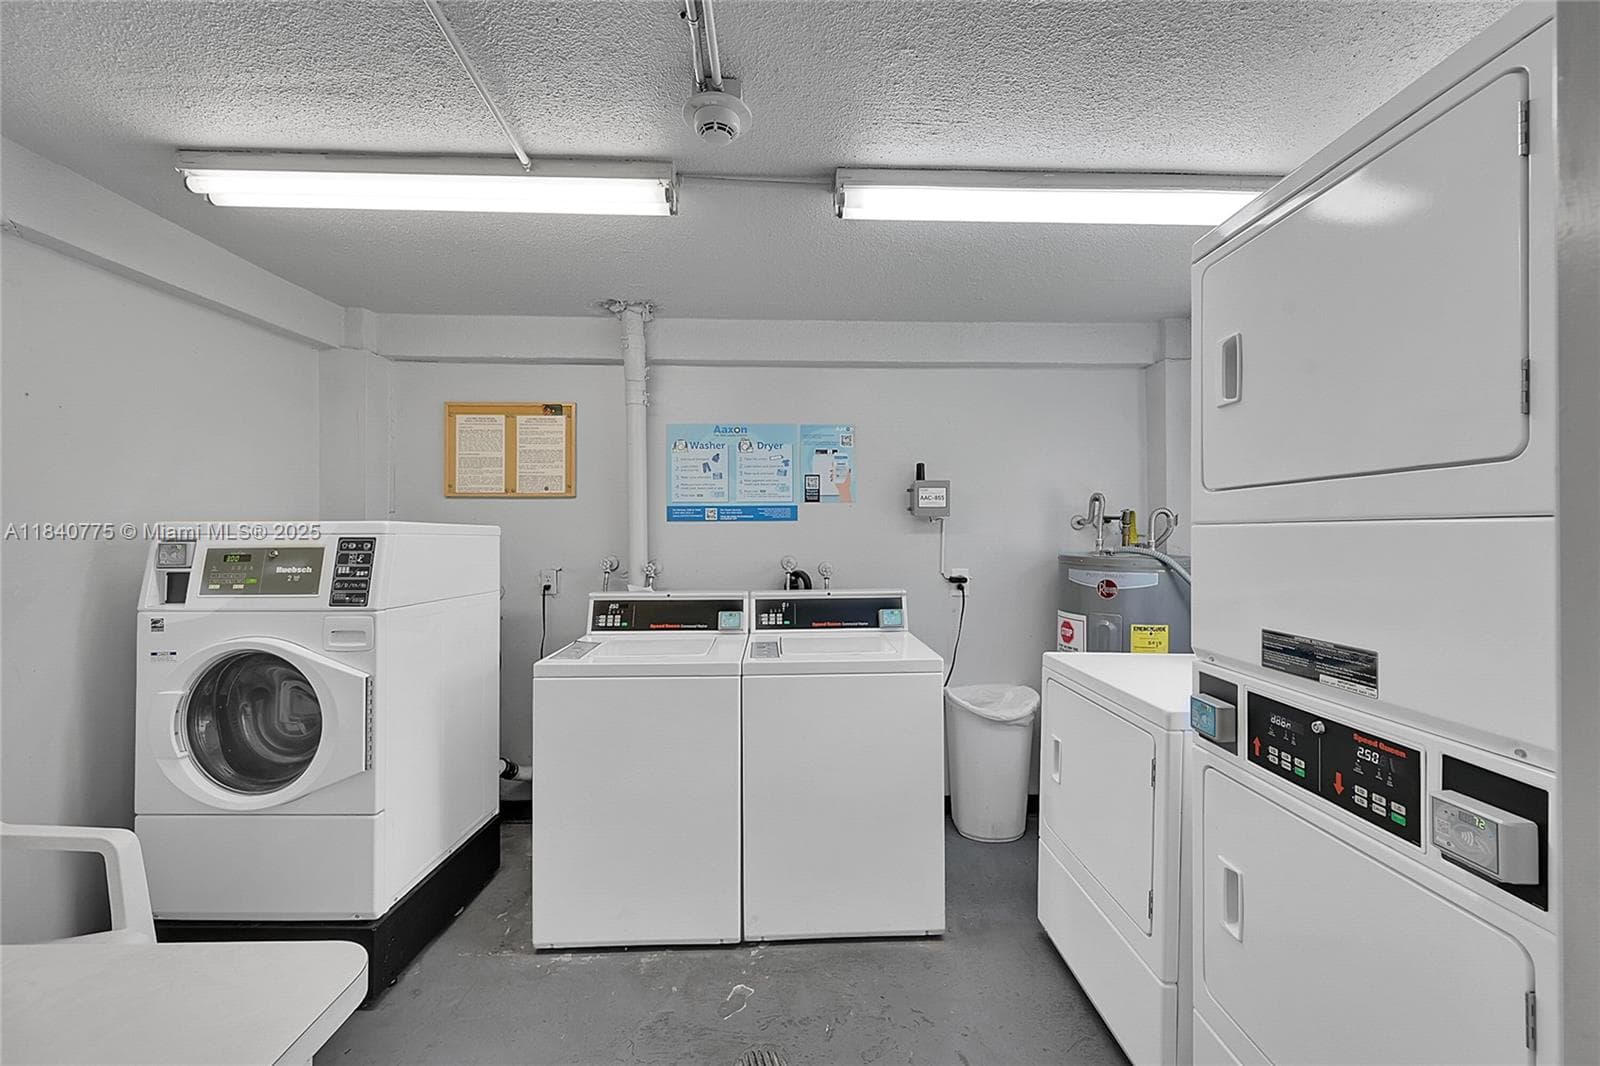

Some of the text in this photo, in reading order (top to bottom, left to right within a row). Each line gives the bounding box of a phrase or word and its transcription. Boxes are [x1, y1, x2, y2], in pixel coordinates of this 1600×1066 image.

[713, 425, 748, 434] Aaxon
[689, 441, 726, 450] Washer
[757, 441, 784, 452] Dryer
[275, 566, 313, 574] Huebsch
[1352, 732, 1378, 748] Speed
